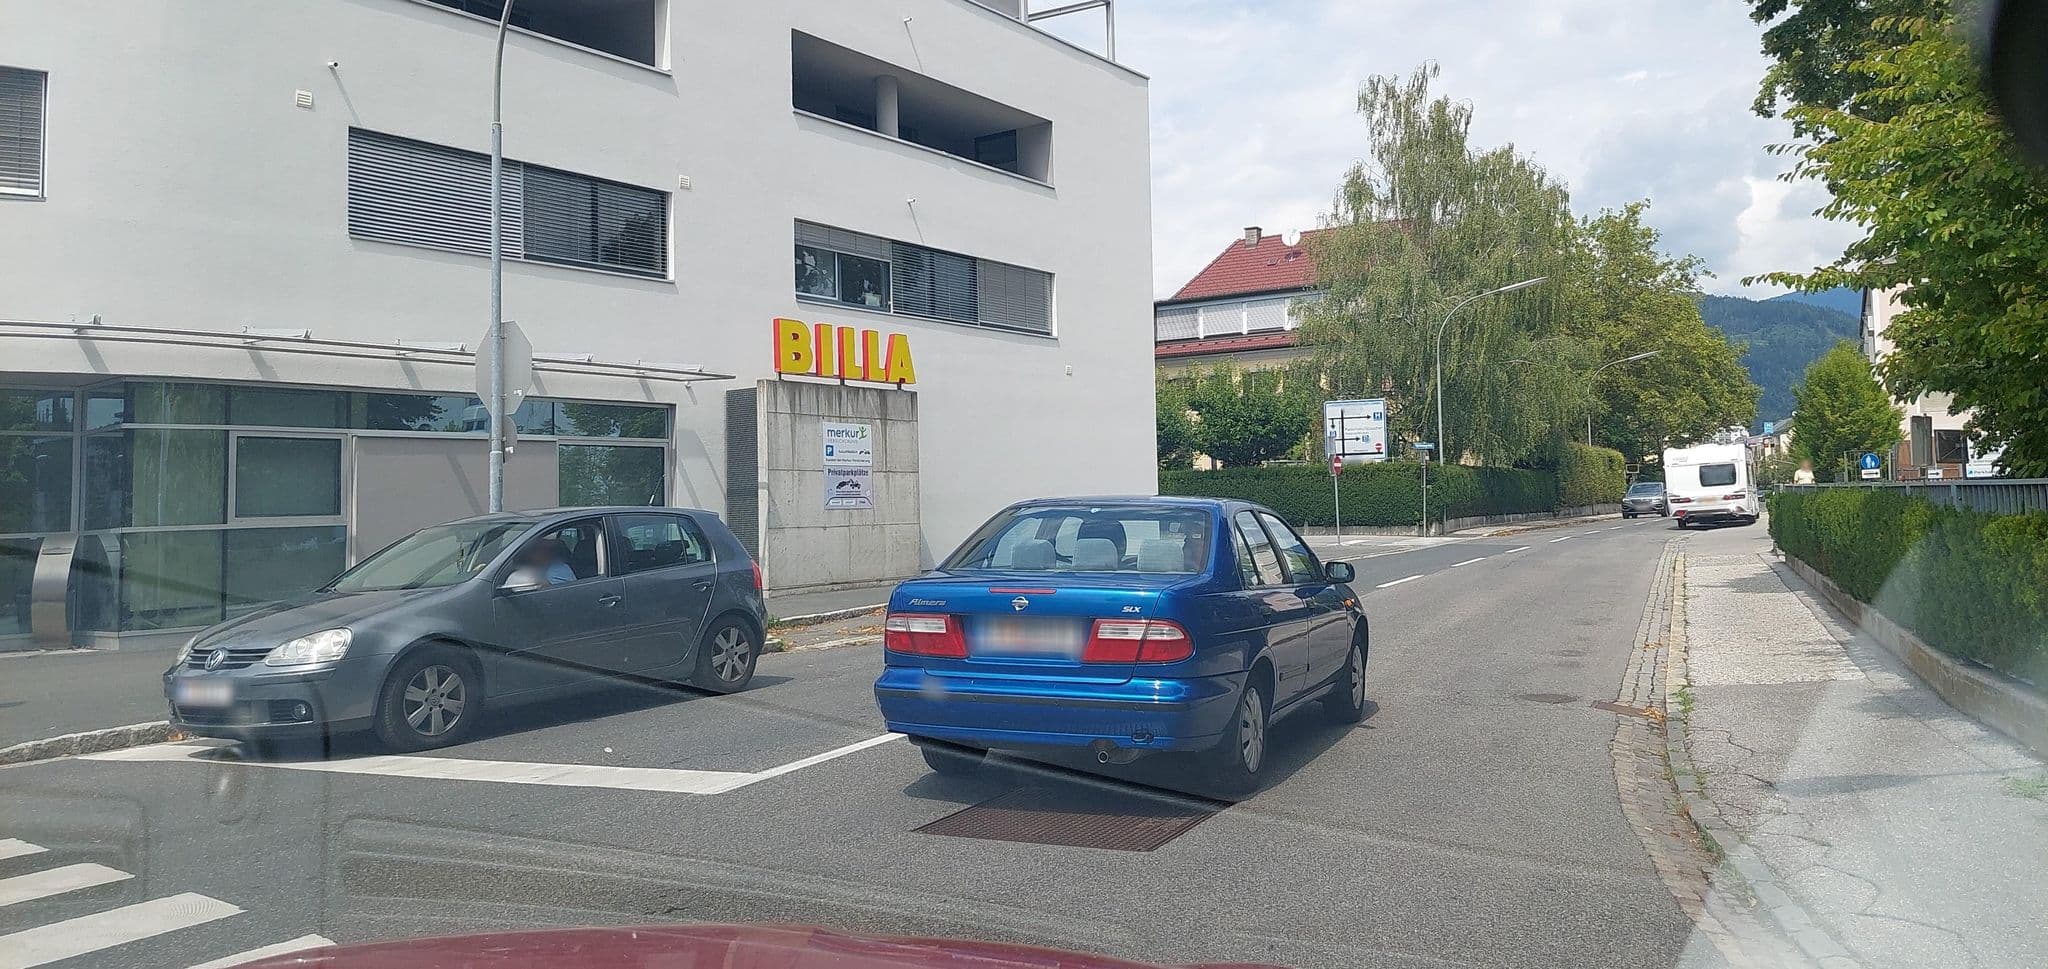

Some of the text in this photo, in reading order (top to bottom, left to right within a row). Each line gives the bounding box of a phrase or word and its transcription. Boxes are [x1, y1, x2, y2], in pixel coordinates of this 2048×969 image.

[773, 318, 916, 384] BILLA
[827, 428, 859, 438] merkur
[908, 598, 947, 606] Almera
[1121, 605, 1142, 613] SLX
